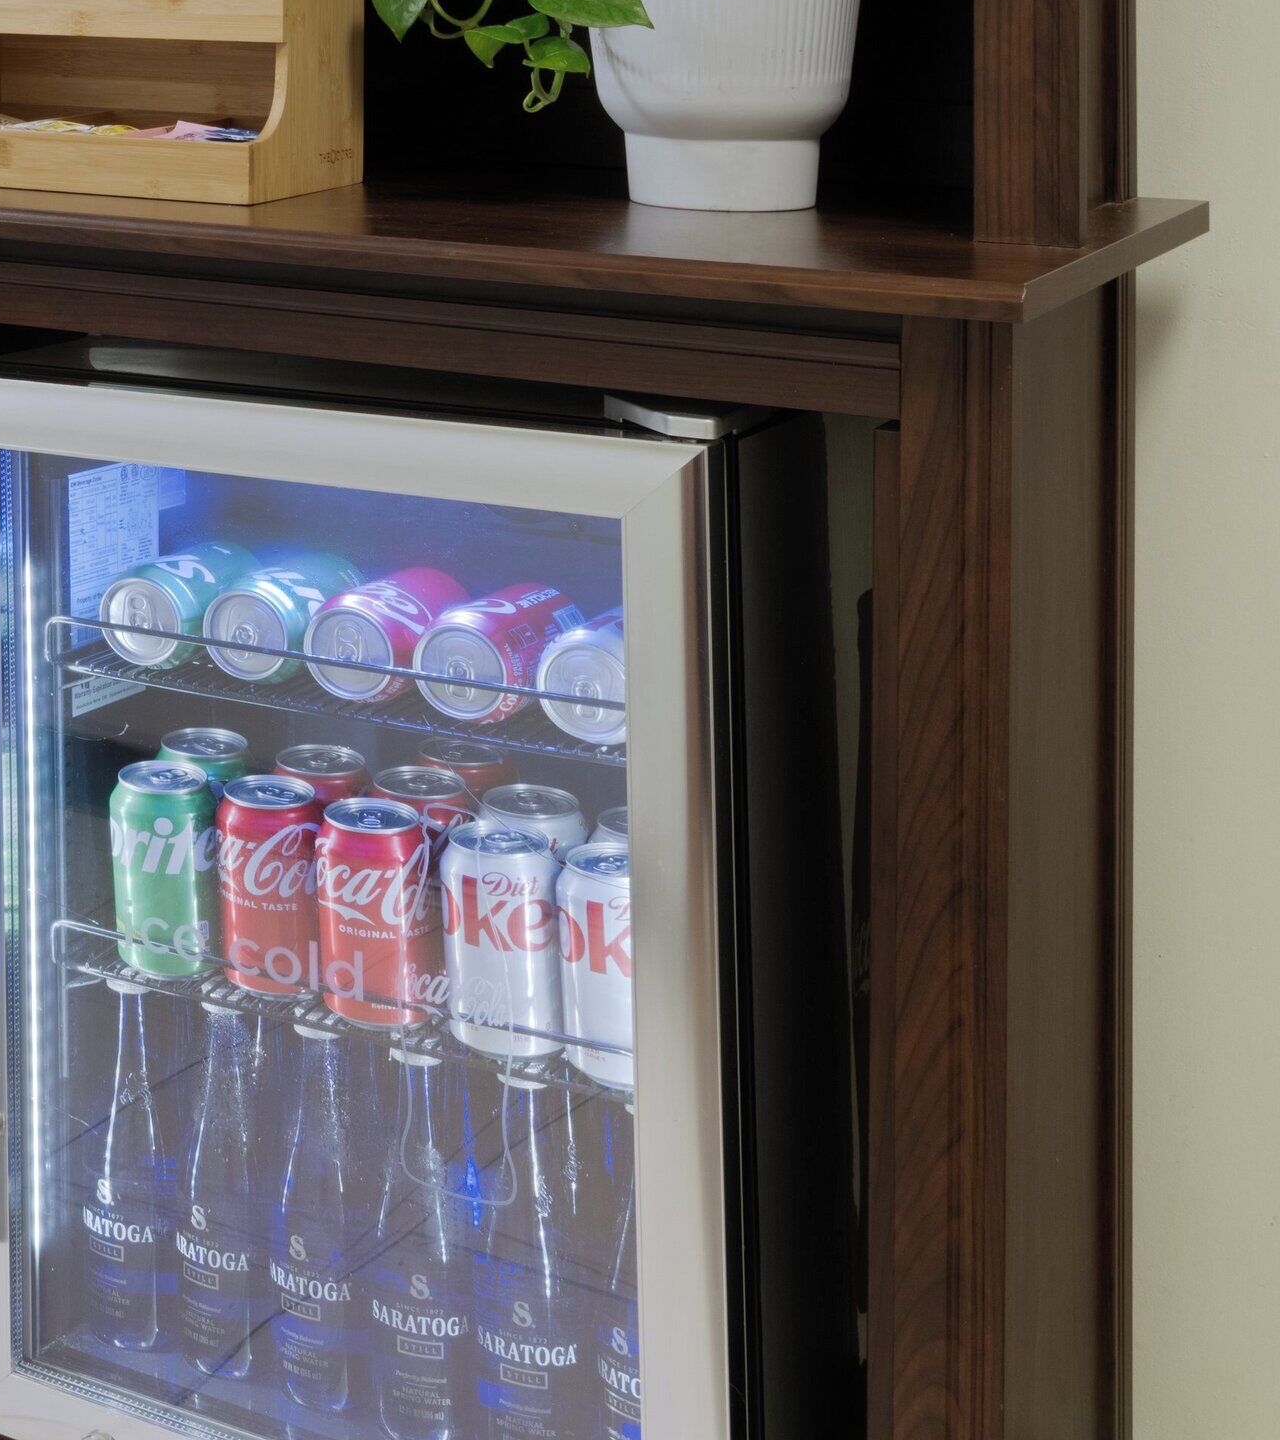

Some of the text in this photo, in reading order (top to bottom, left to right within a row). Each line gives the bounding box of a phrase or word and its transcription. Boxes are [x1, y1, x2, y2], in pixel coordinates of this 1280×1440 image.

[482, 871, 540, 897] Diet
[261, 902, 299, 912] TASTE
[338, 924, 397, 940] ORIGINAL
[229, 937, 365, 1002] cold
[372, 1299, 469, 1337] SARATOGA
[403, 1341, 438, 1354] STILL
[477, 1324, 578, 1367] SARATOGA
[506, 1369, 541, 1384] STILL
